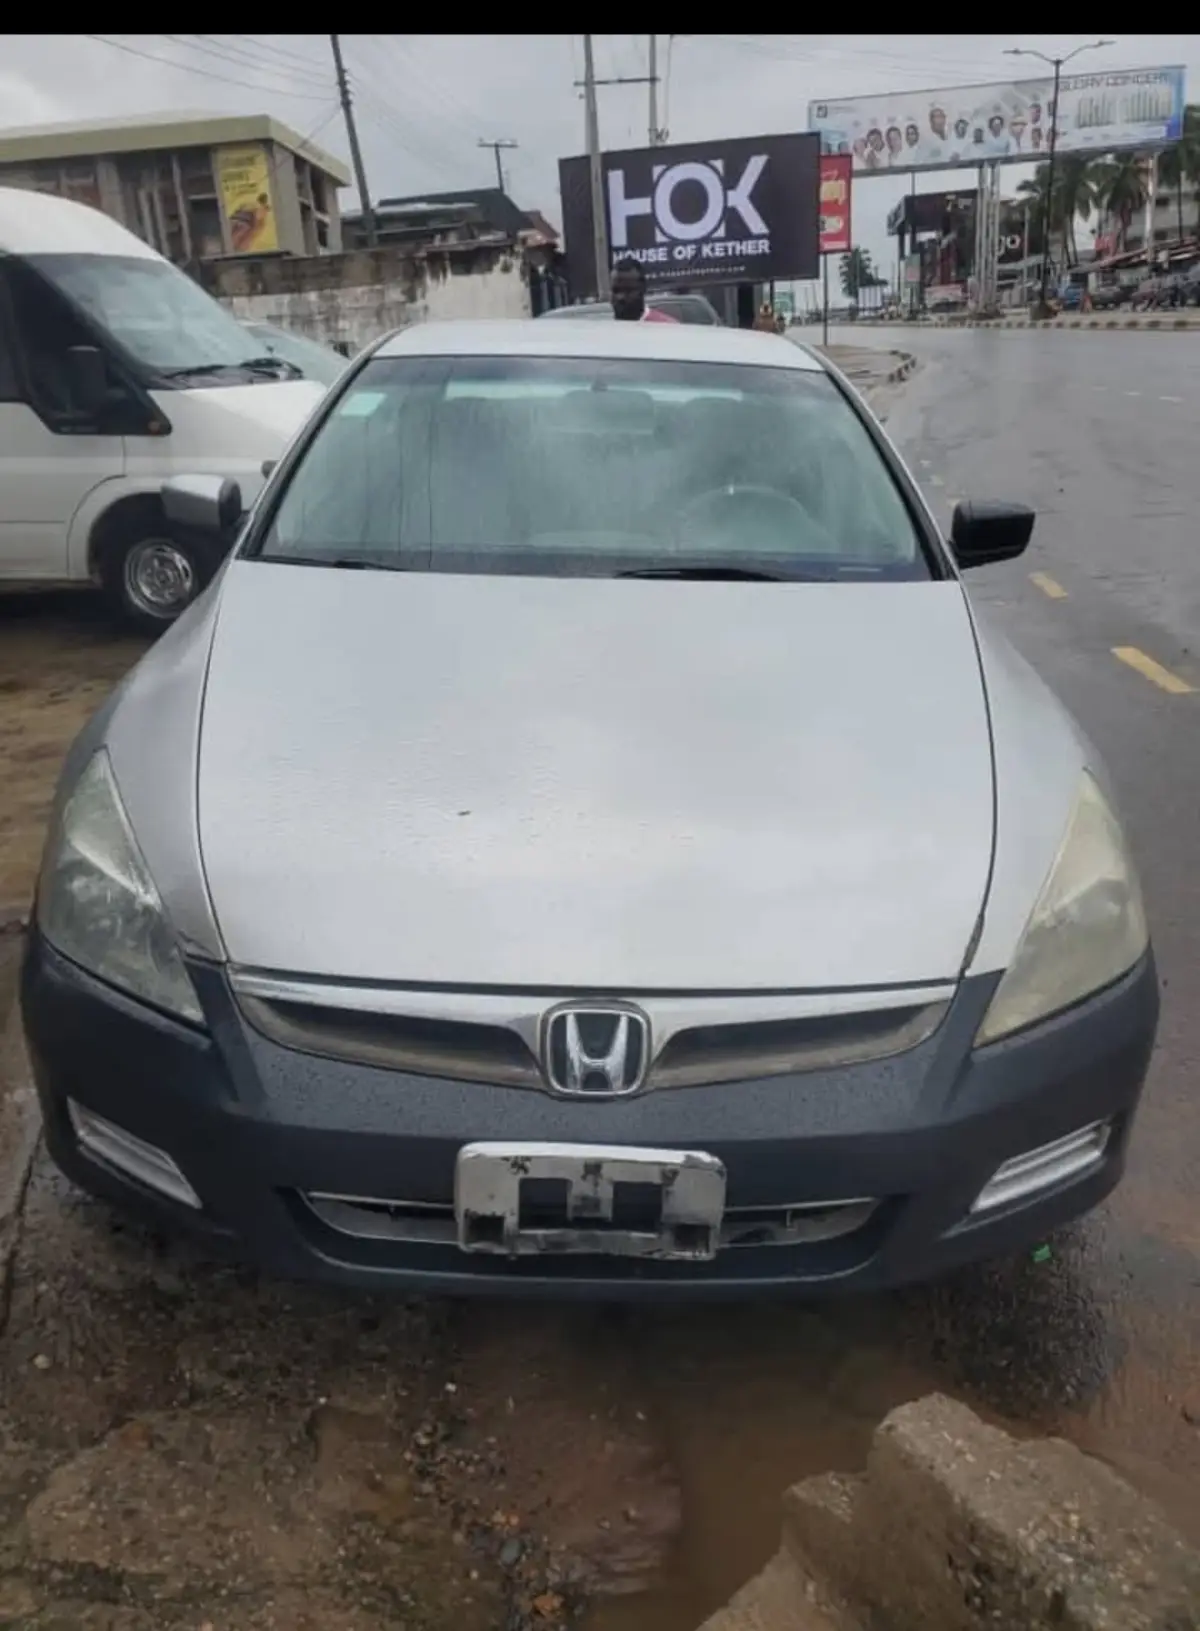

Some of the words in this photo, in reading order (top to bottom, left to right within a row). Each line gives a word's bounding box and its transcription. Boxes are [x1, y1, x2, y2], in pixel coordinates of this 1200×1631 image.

[607, 154, 770, 247] HOK
[672, 245, 697, 260] OF
[702, 240, 771, 258] KETHER
